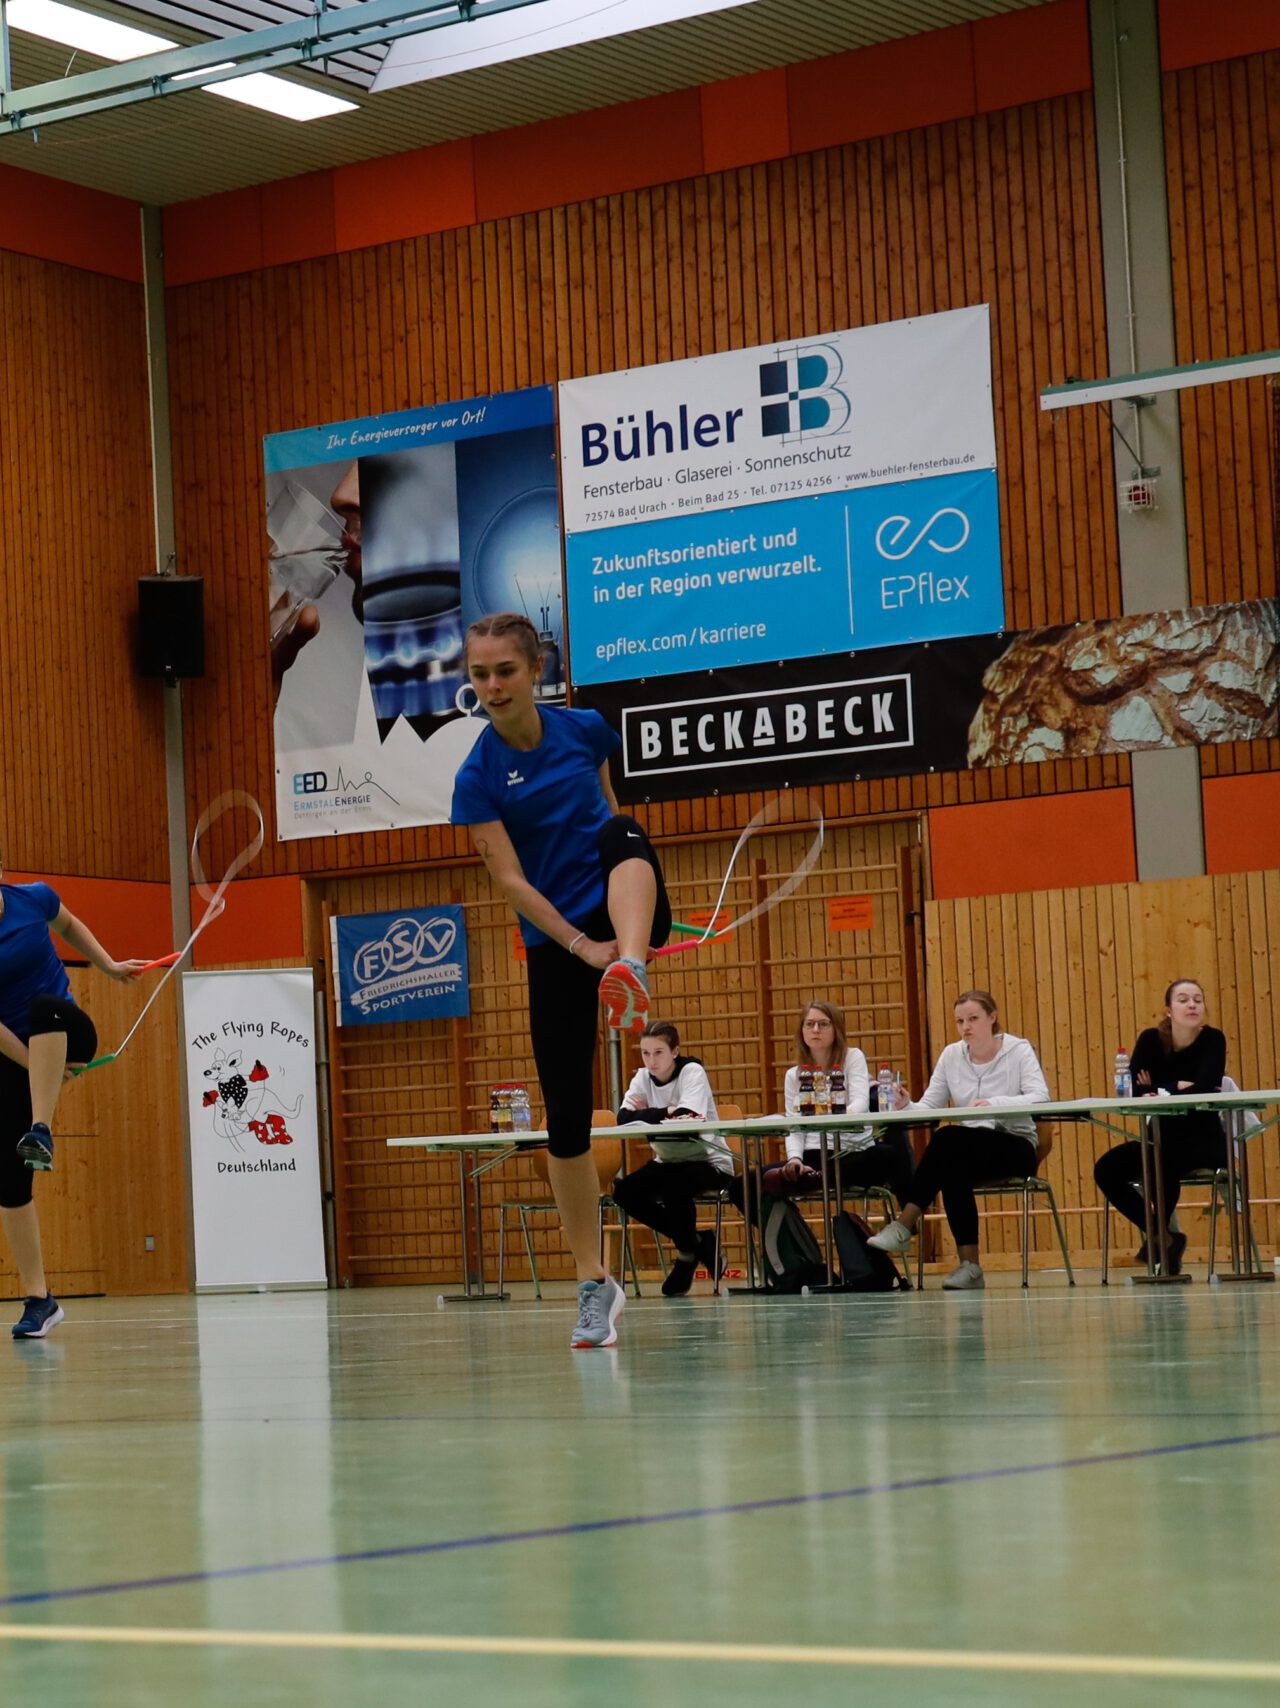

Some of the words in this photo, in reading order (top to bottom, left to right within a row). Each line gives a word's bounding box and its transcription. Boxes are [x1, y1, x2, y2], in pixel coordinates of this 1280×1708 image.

[325, 433, 346, 450] Ihr
[350, 418, 438, 448] Energieversorger
[441, 415, 458, 428] vor
[461, 407, 486, 425] Ort!
[581, 405, 743, 467] Bühler
[584, 476, 663, 499] Fensterbau
[675, 460, 732, 484] Glaserei
[745, 445, 852, 473] Sonnenschutz
[585, 508, 615, 523] 72574
[618, 506, 636, 517] Bad
[639, 501, 667, 514] Urach
[678, 496, 703, 507] Beim
[706, 492, 724, 504] Bad
[727, 489, 739, 500] 25
[750, 485, 767, 496] Tel.
[770, 480, 803, 493] 07125
[806, 476, 832, 489] 4256
[846, 453, 975, 482] www.buehler-fensterbau.de
[592, 533, 758, 576] Zukunftsorientiert
[763, 527, 797, 551] und
[593, 586, 610, 604] in
[615, 578, 643, 601] der
[650, 571, 712, 600] Region
[717, 556, 822, 586] verwurzelt.
[881, 572, 970, 610] EPflex
[596, 621, 767, 661] epflex.com/karriere
[293, 771, 327, 795] EED
[294, 794, 371, 812] ERMSTALENERGIE
[363, 929, 453, 979] FSV
[360, 969, 456, 1000] FRIEDRICHSHALLER
[360, 984, 456, 1015] SPORTVEREIN
[192, 1029, 218, 1051] The
[221, 1020, 264, 1038] Flying
[270, 1020, 310, 1048] Ropes
[217, 1159, 296, 1174] Deutschland
